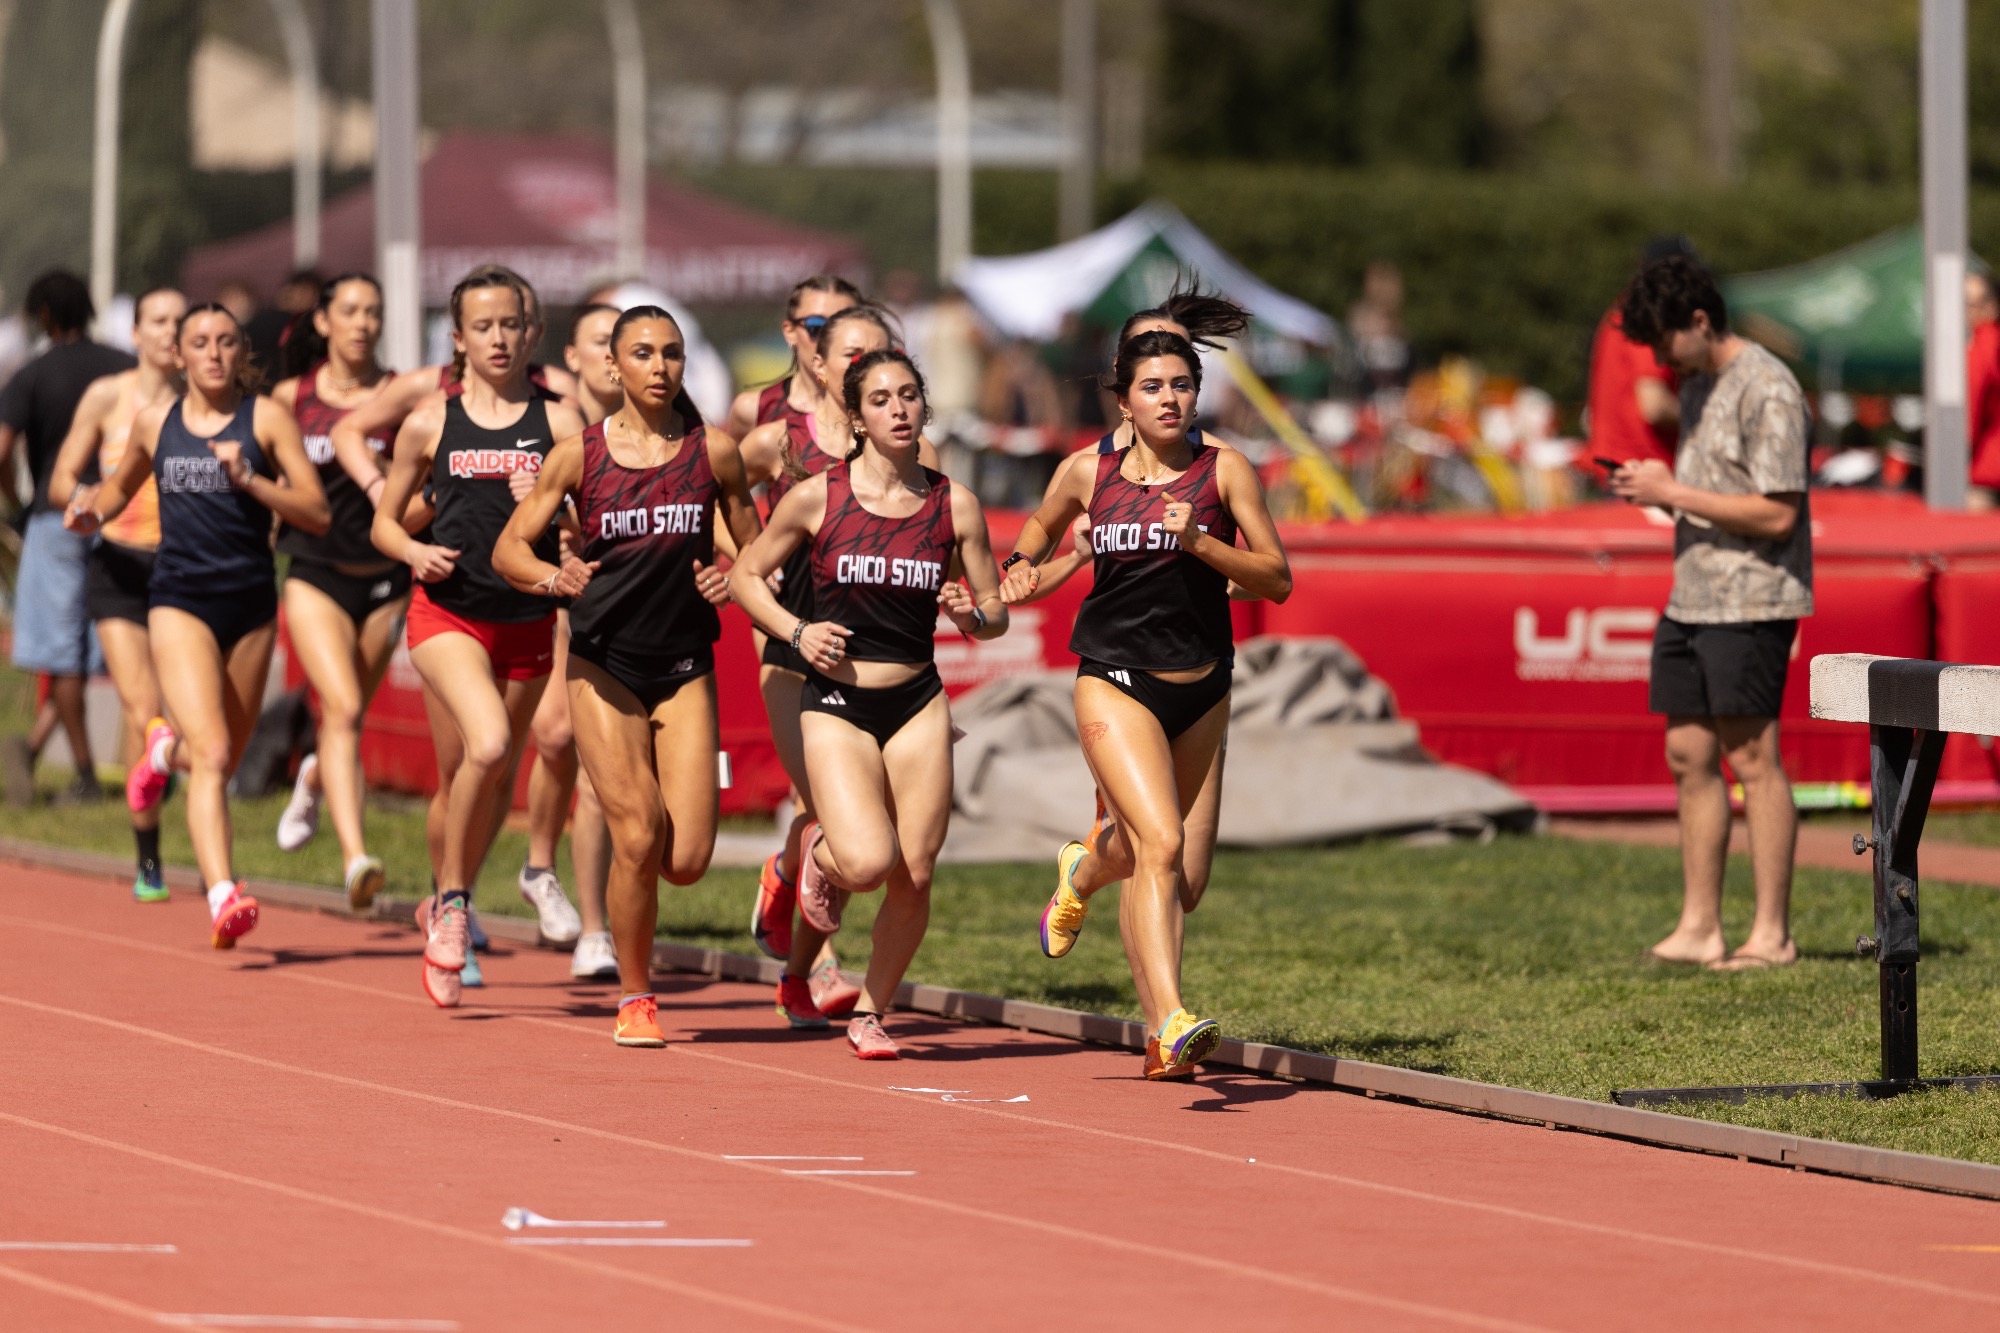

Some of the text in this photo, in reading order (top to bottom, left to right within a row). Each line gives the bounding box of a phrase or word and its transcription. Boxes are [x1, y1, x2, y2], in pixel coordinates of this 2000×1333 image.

[449, 449, 543, 479] RAIDERS
[601, 504, 704, 540] CHICO STATE
[1093, 523, 1141, 555] CHICO
[837, 554, 941, 591] CHICO STATE
[1513, 606, 1657, 661] UC
